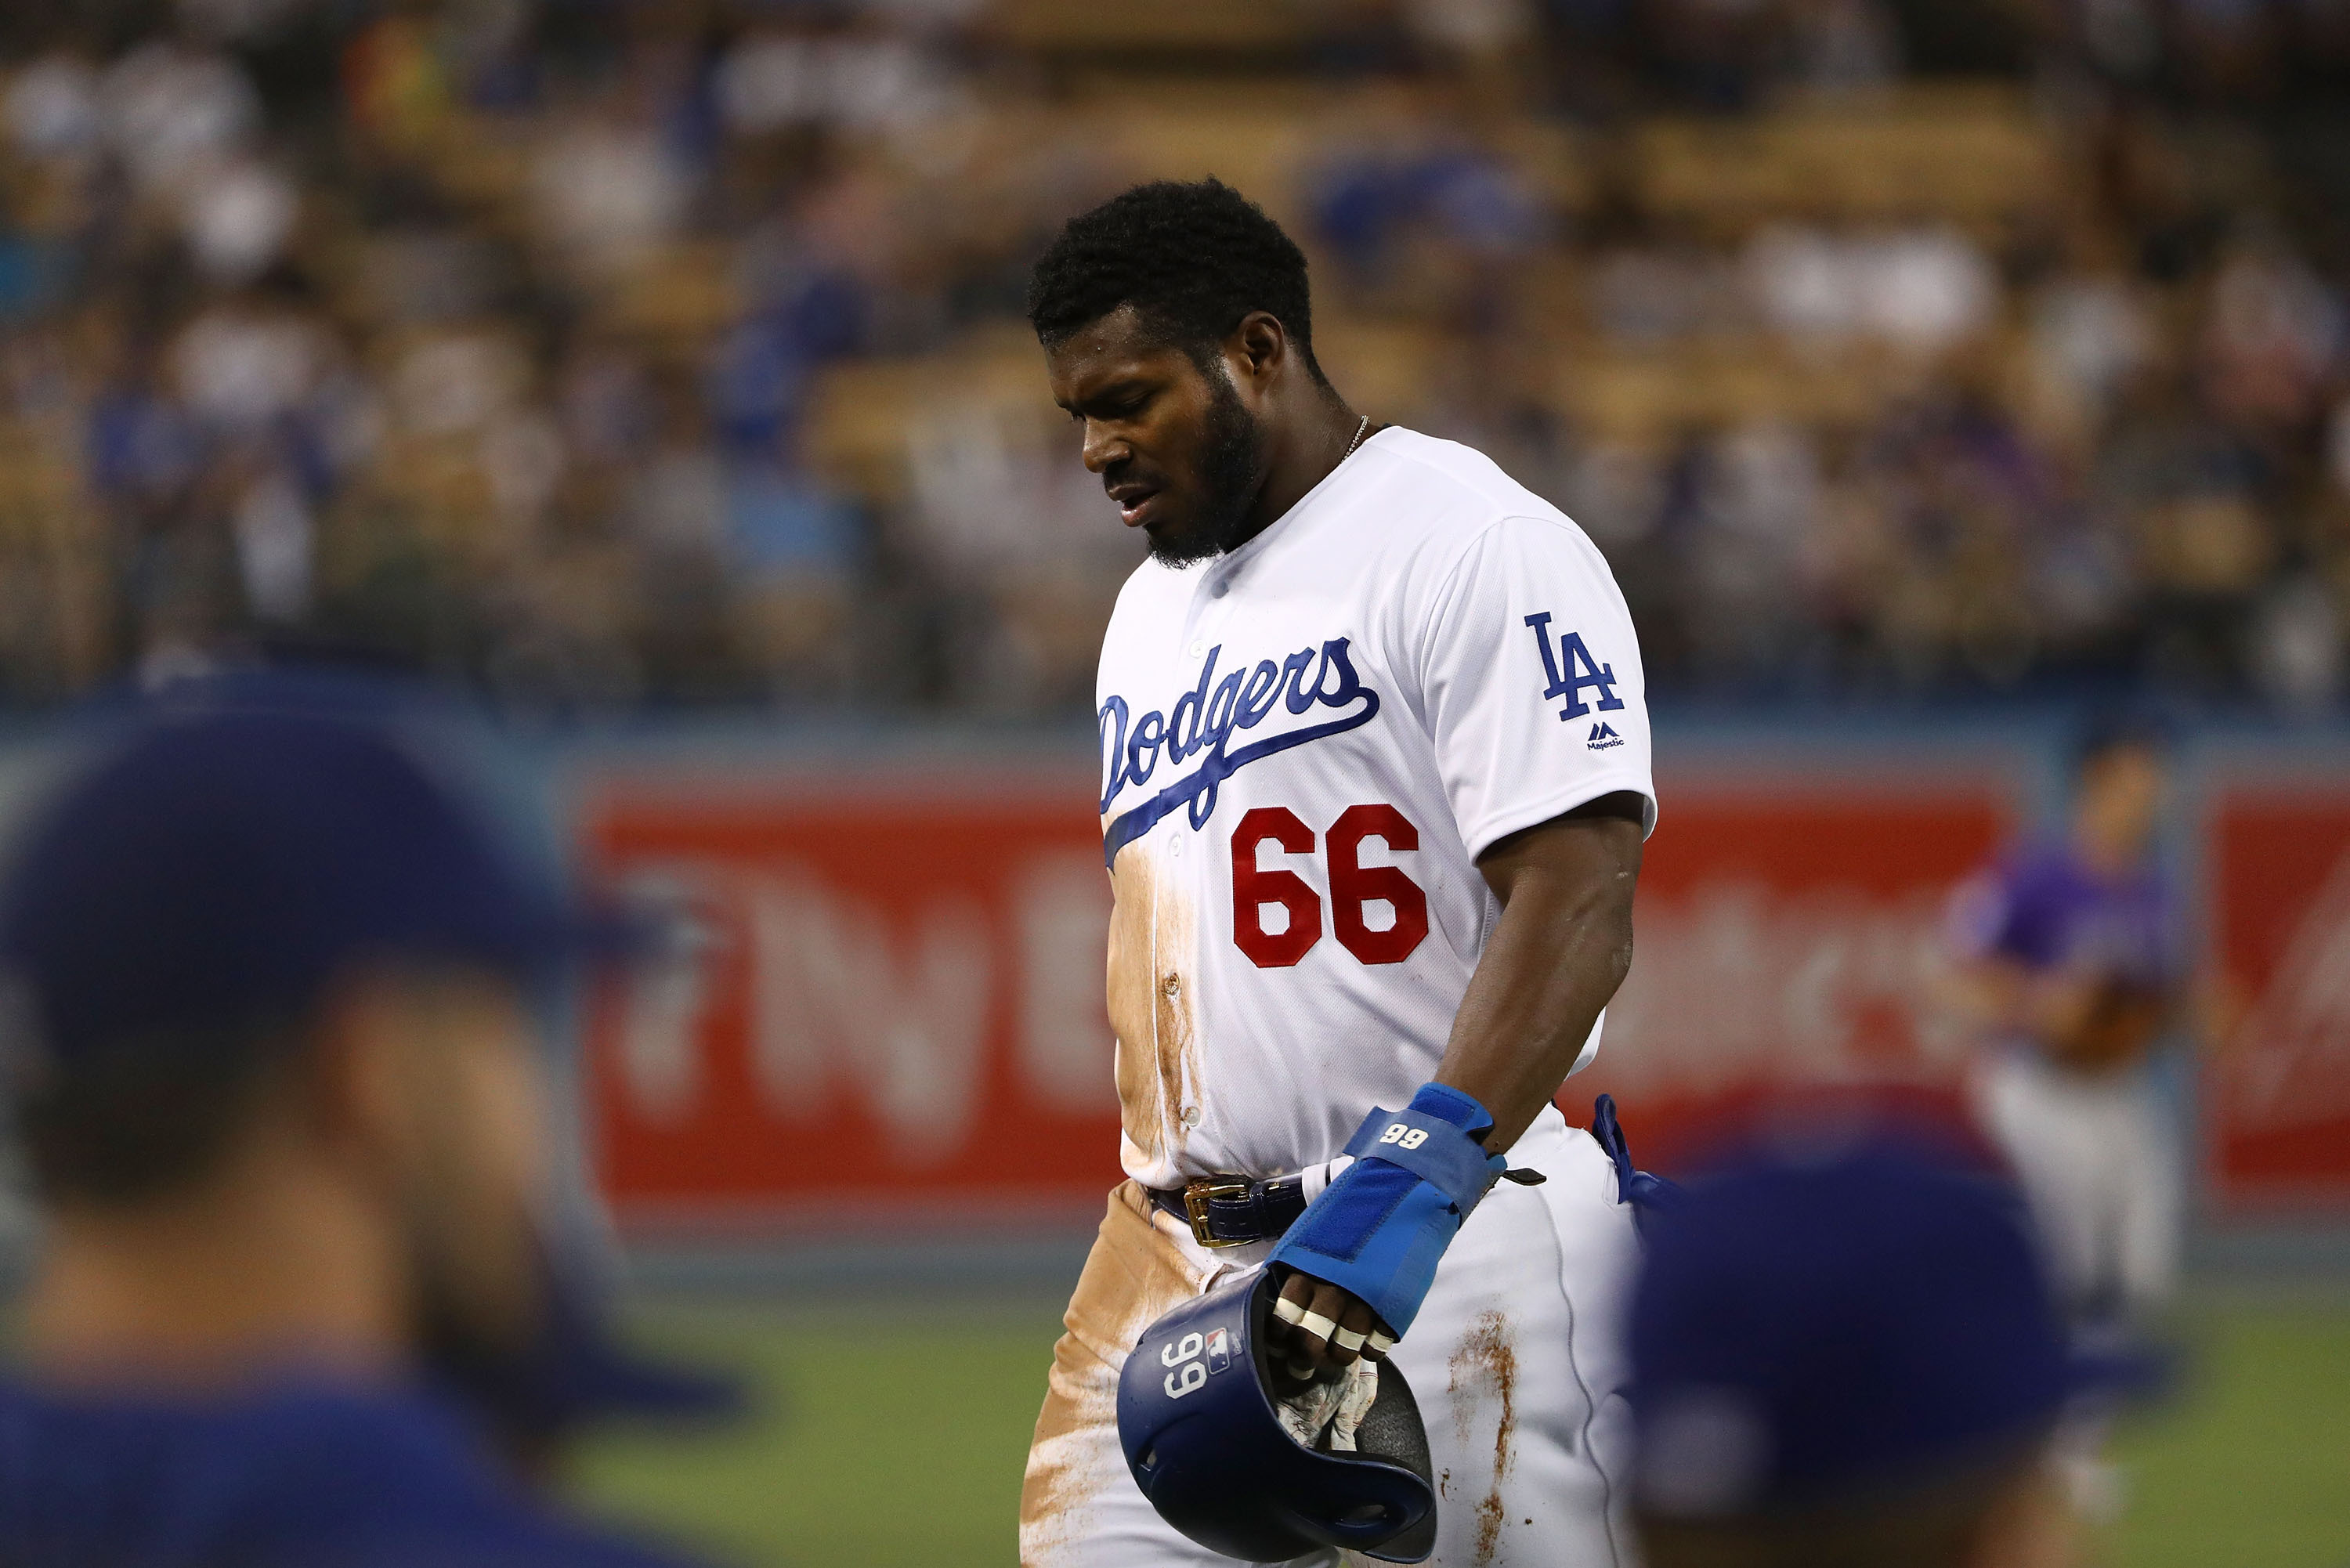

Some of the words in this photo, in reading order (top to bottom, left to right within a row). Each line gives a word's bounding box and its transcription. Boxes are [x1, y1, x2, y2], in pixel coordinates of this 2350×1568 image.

[1524, 611, 1625, 721] LA
[1099, 637, 1379, 835] Dodgers
[1587, 737, 1625, 751] Majestic
[1231, 804, 1430, 968] 66
